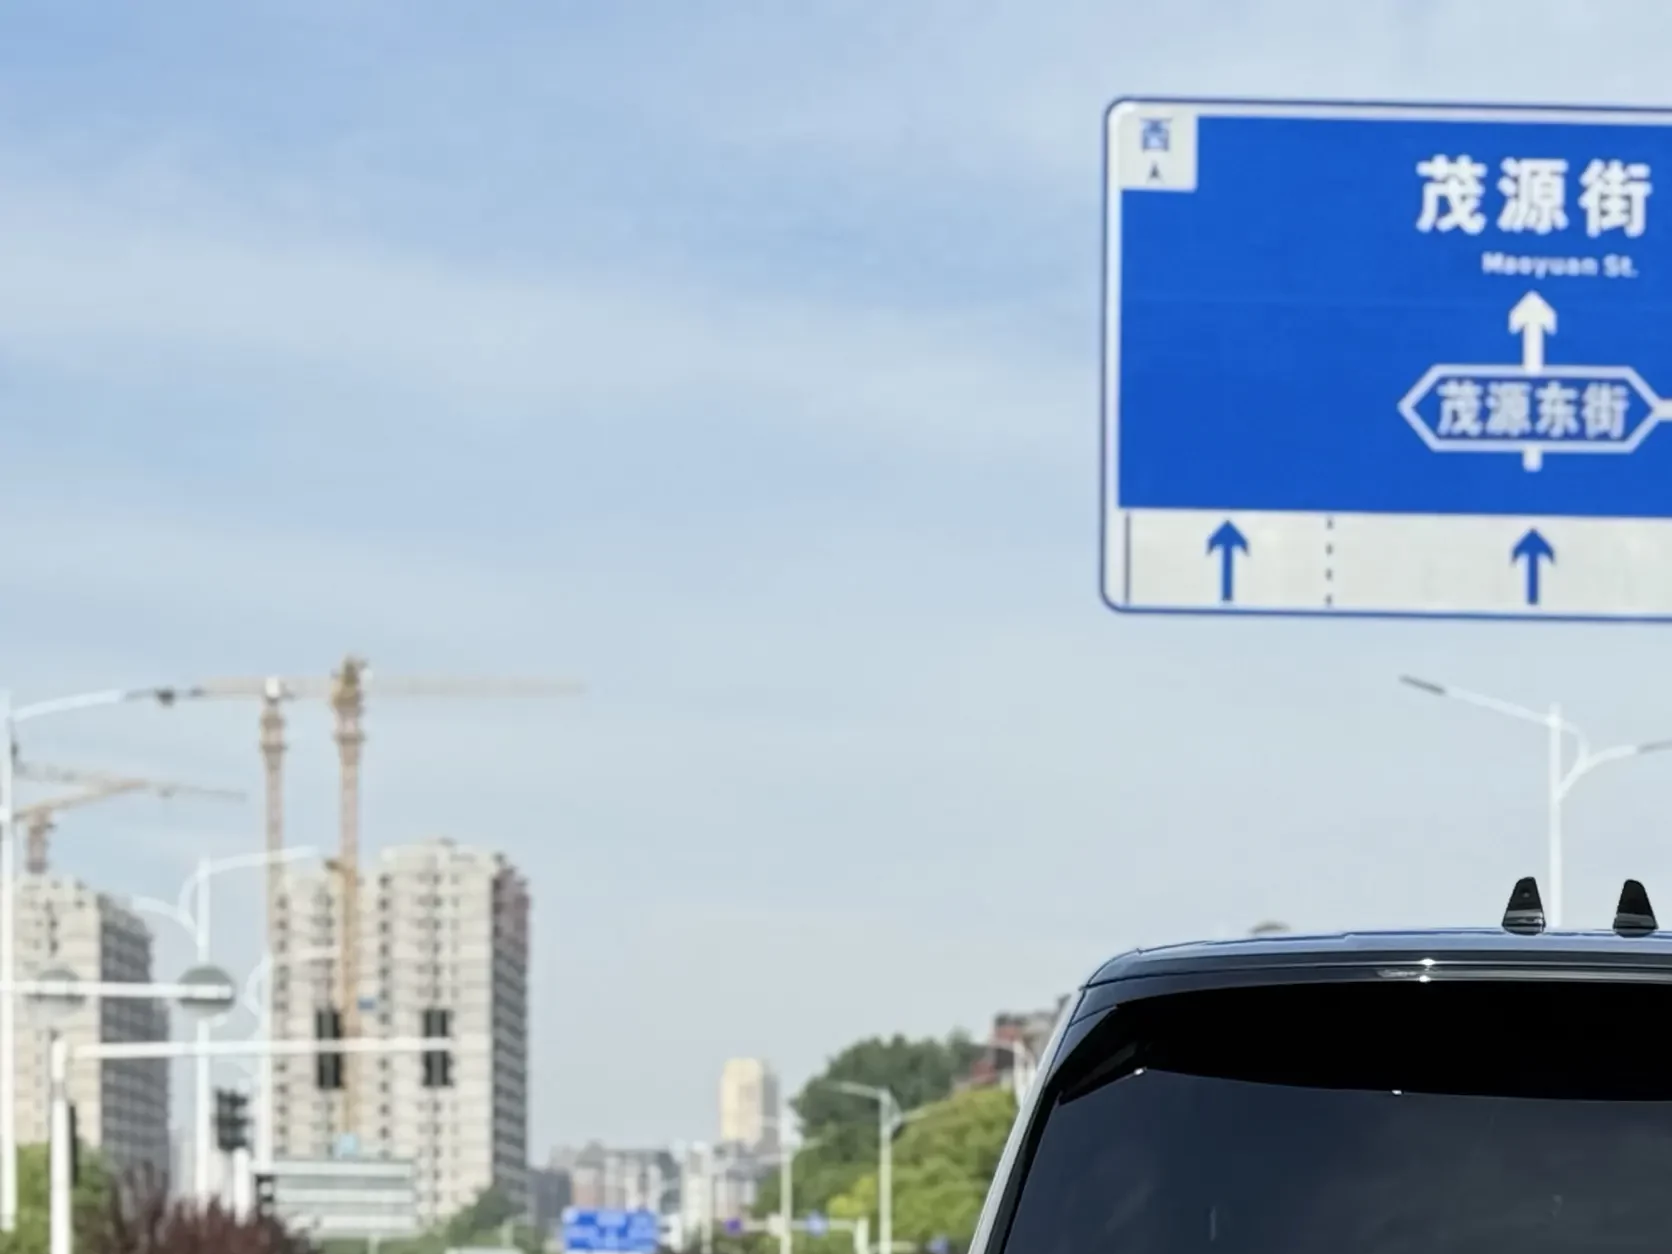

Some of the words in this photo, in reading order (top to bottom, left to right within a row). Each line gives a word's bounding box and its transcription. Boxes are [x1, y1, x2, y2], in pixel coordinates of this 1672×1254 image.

[1140, 118, 1172, 153] 西
[1415, 154, 1653, 239] 茂源街
[1481, 251, 1599, 279] Maoyuan
[1603, 253, 1640, 279] St.
[1436, 380, 1630, 439] 茂源东街
